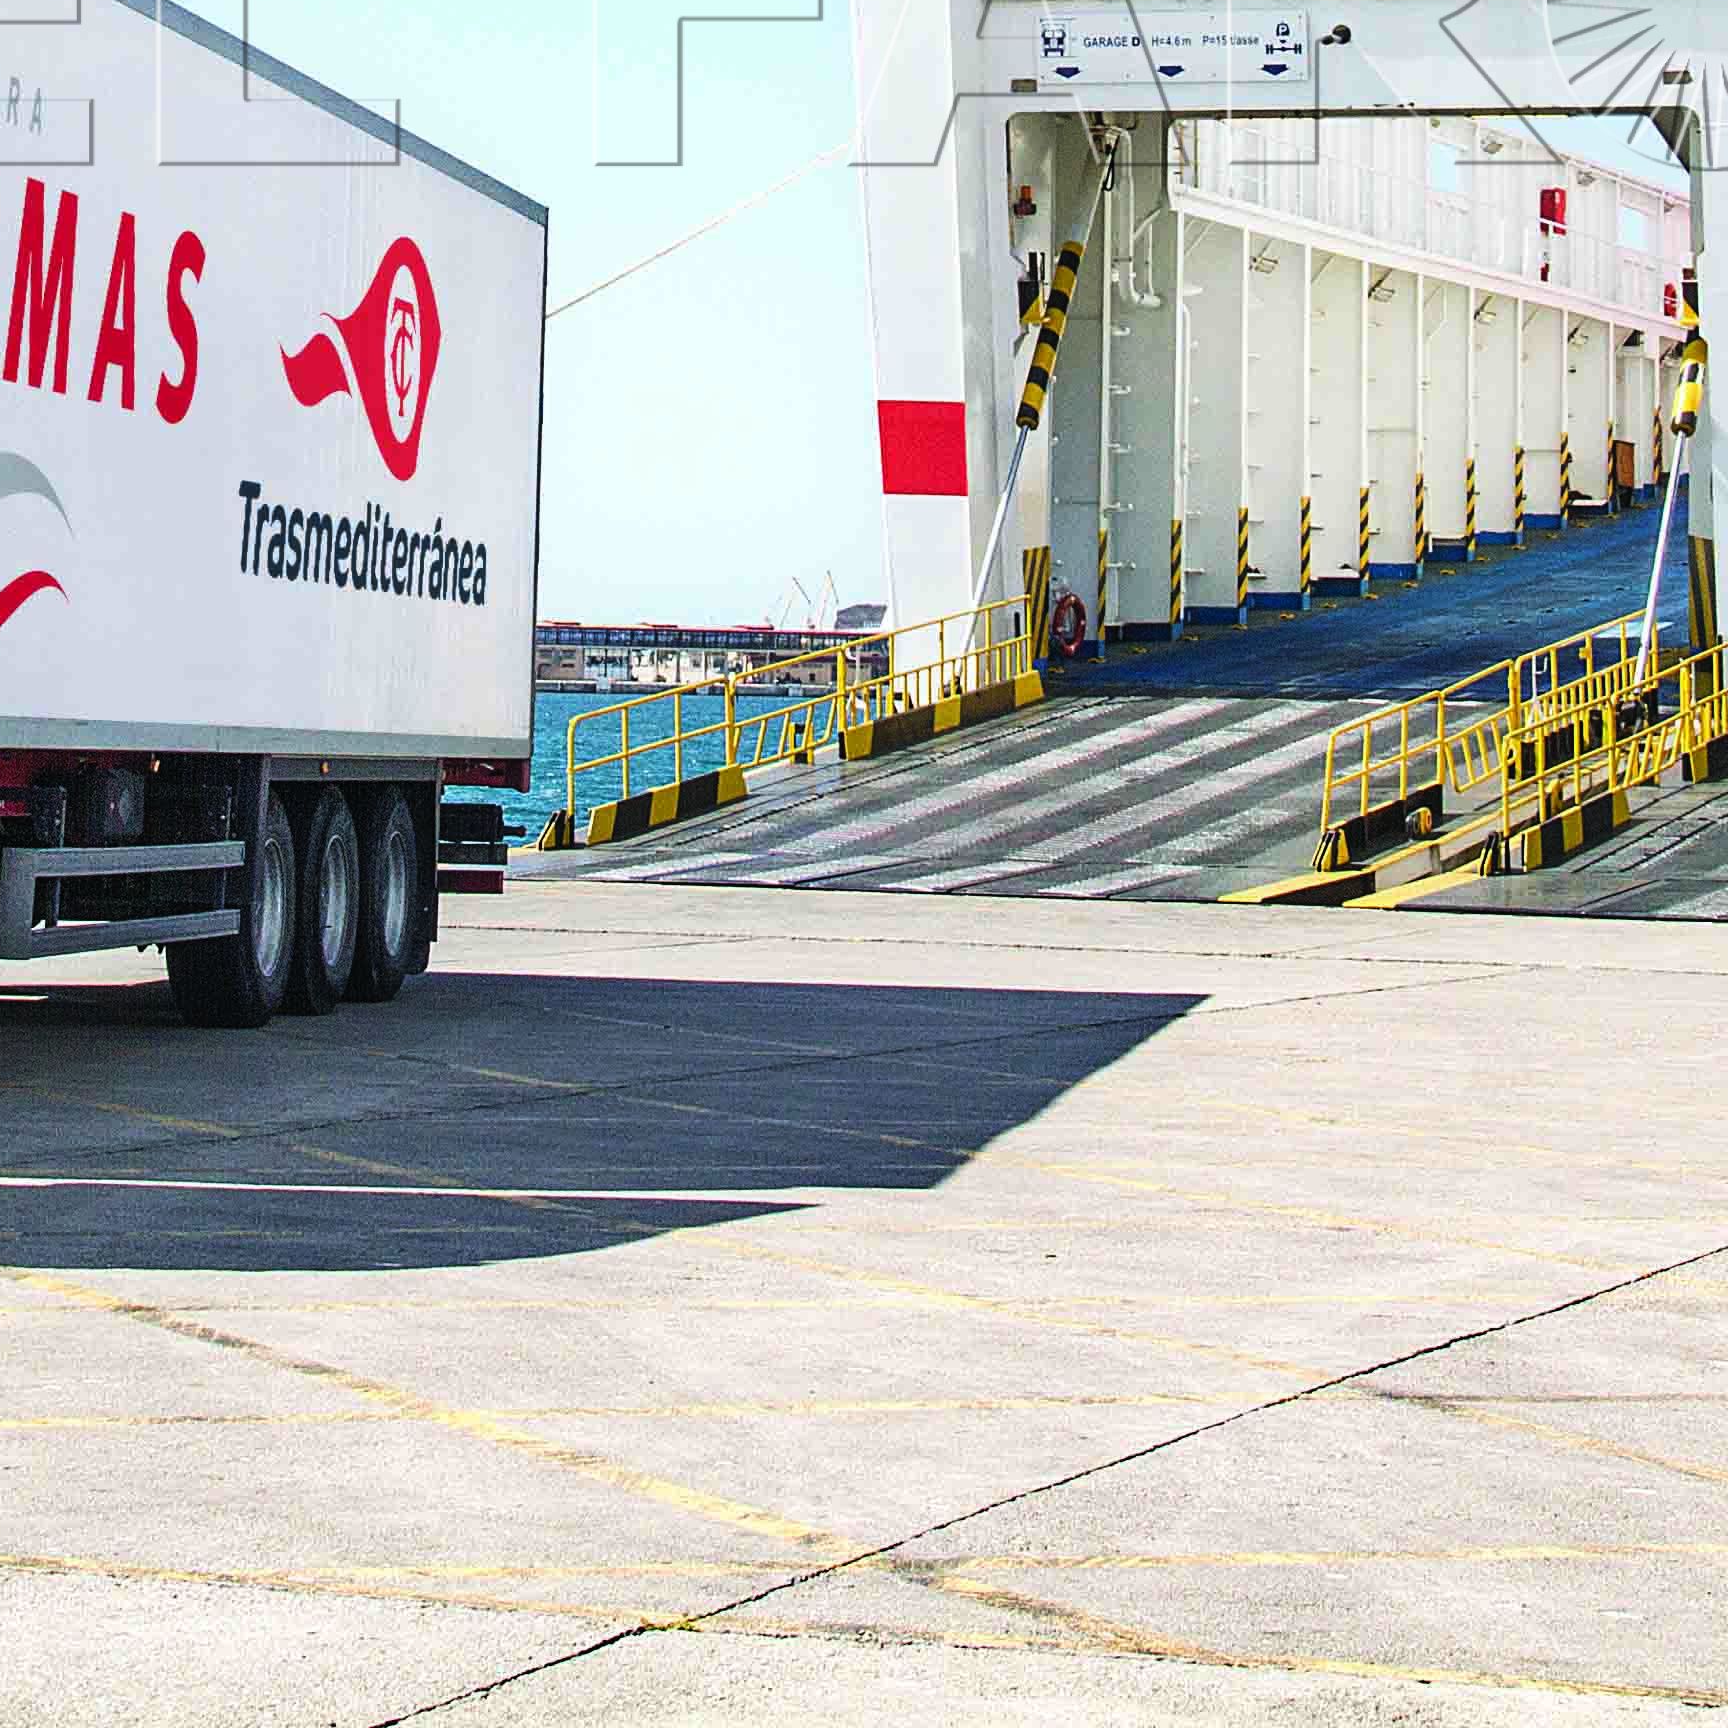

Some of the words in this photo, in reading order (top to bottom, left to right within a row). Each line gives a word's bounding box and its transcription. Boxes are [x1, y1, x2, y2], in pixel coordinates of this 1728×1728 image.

[1083, 36, 1129, 48] GARAGE
[1131, 36, 1140, 47] D
[1201, 34, 1227, 46] P=15
[238, 479, 487, 606] Trasmediterránea
